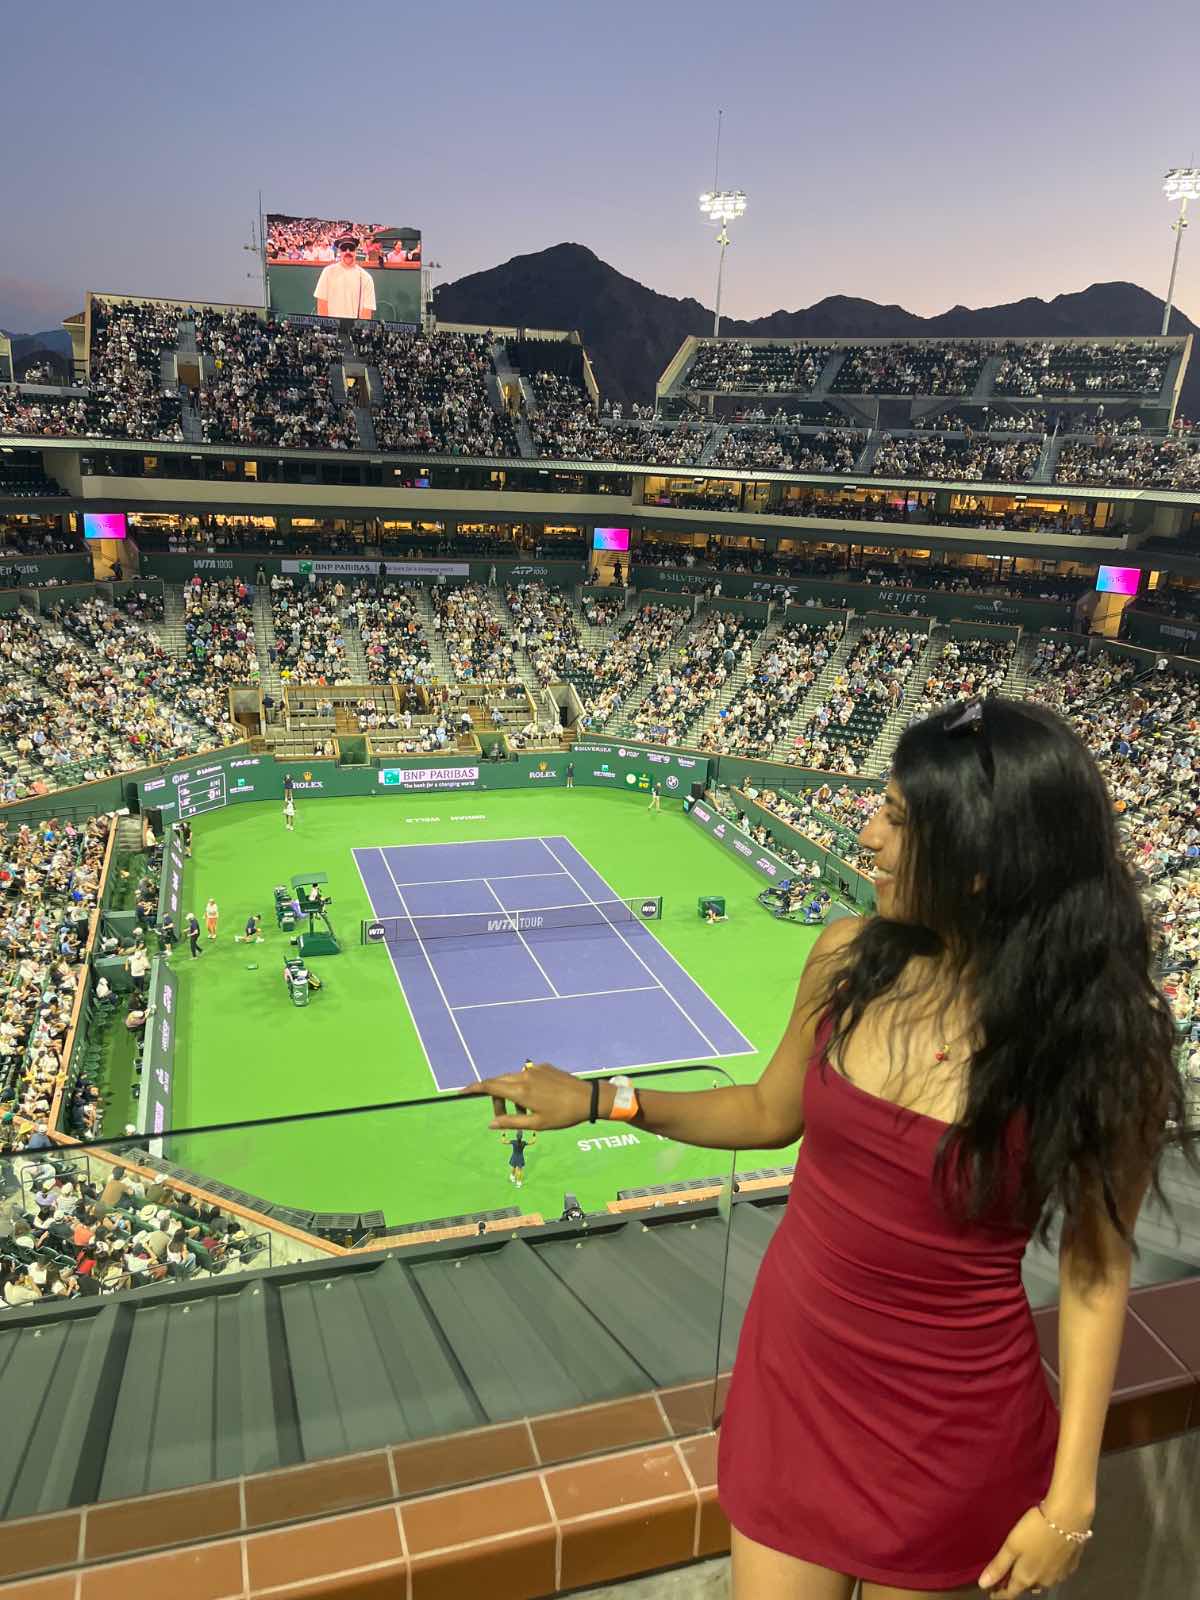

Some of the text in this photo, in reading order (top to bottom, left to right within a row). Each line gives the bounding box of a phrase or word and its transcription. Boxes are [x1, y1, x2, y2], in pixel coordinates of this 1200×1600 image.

[194, 560, 215, 568] WTA
[879, 592, 927, 603] NETJETS
[404, 769, 475, 780] BNP PARIBAS
[292, 781, 324, 789] ROLEX
[488, 916, 544, 931] WTA TOUR
[577, 1133, 641, 1152] WELLS
